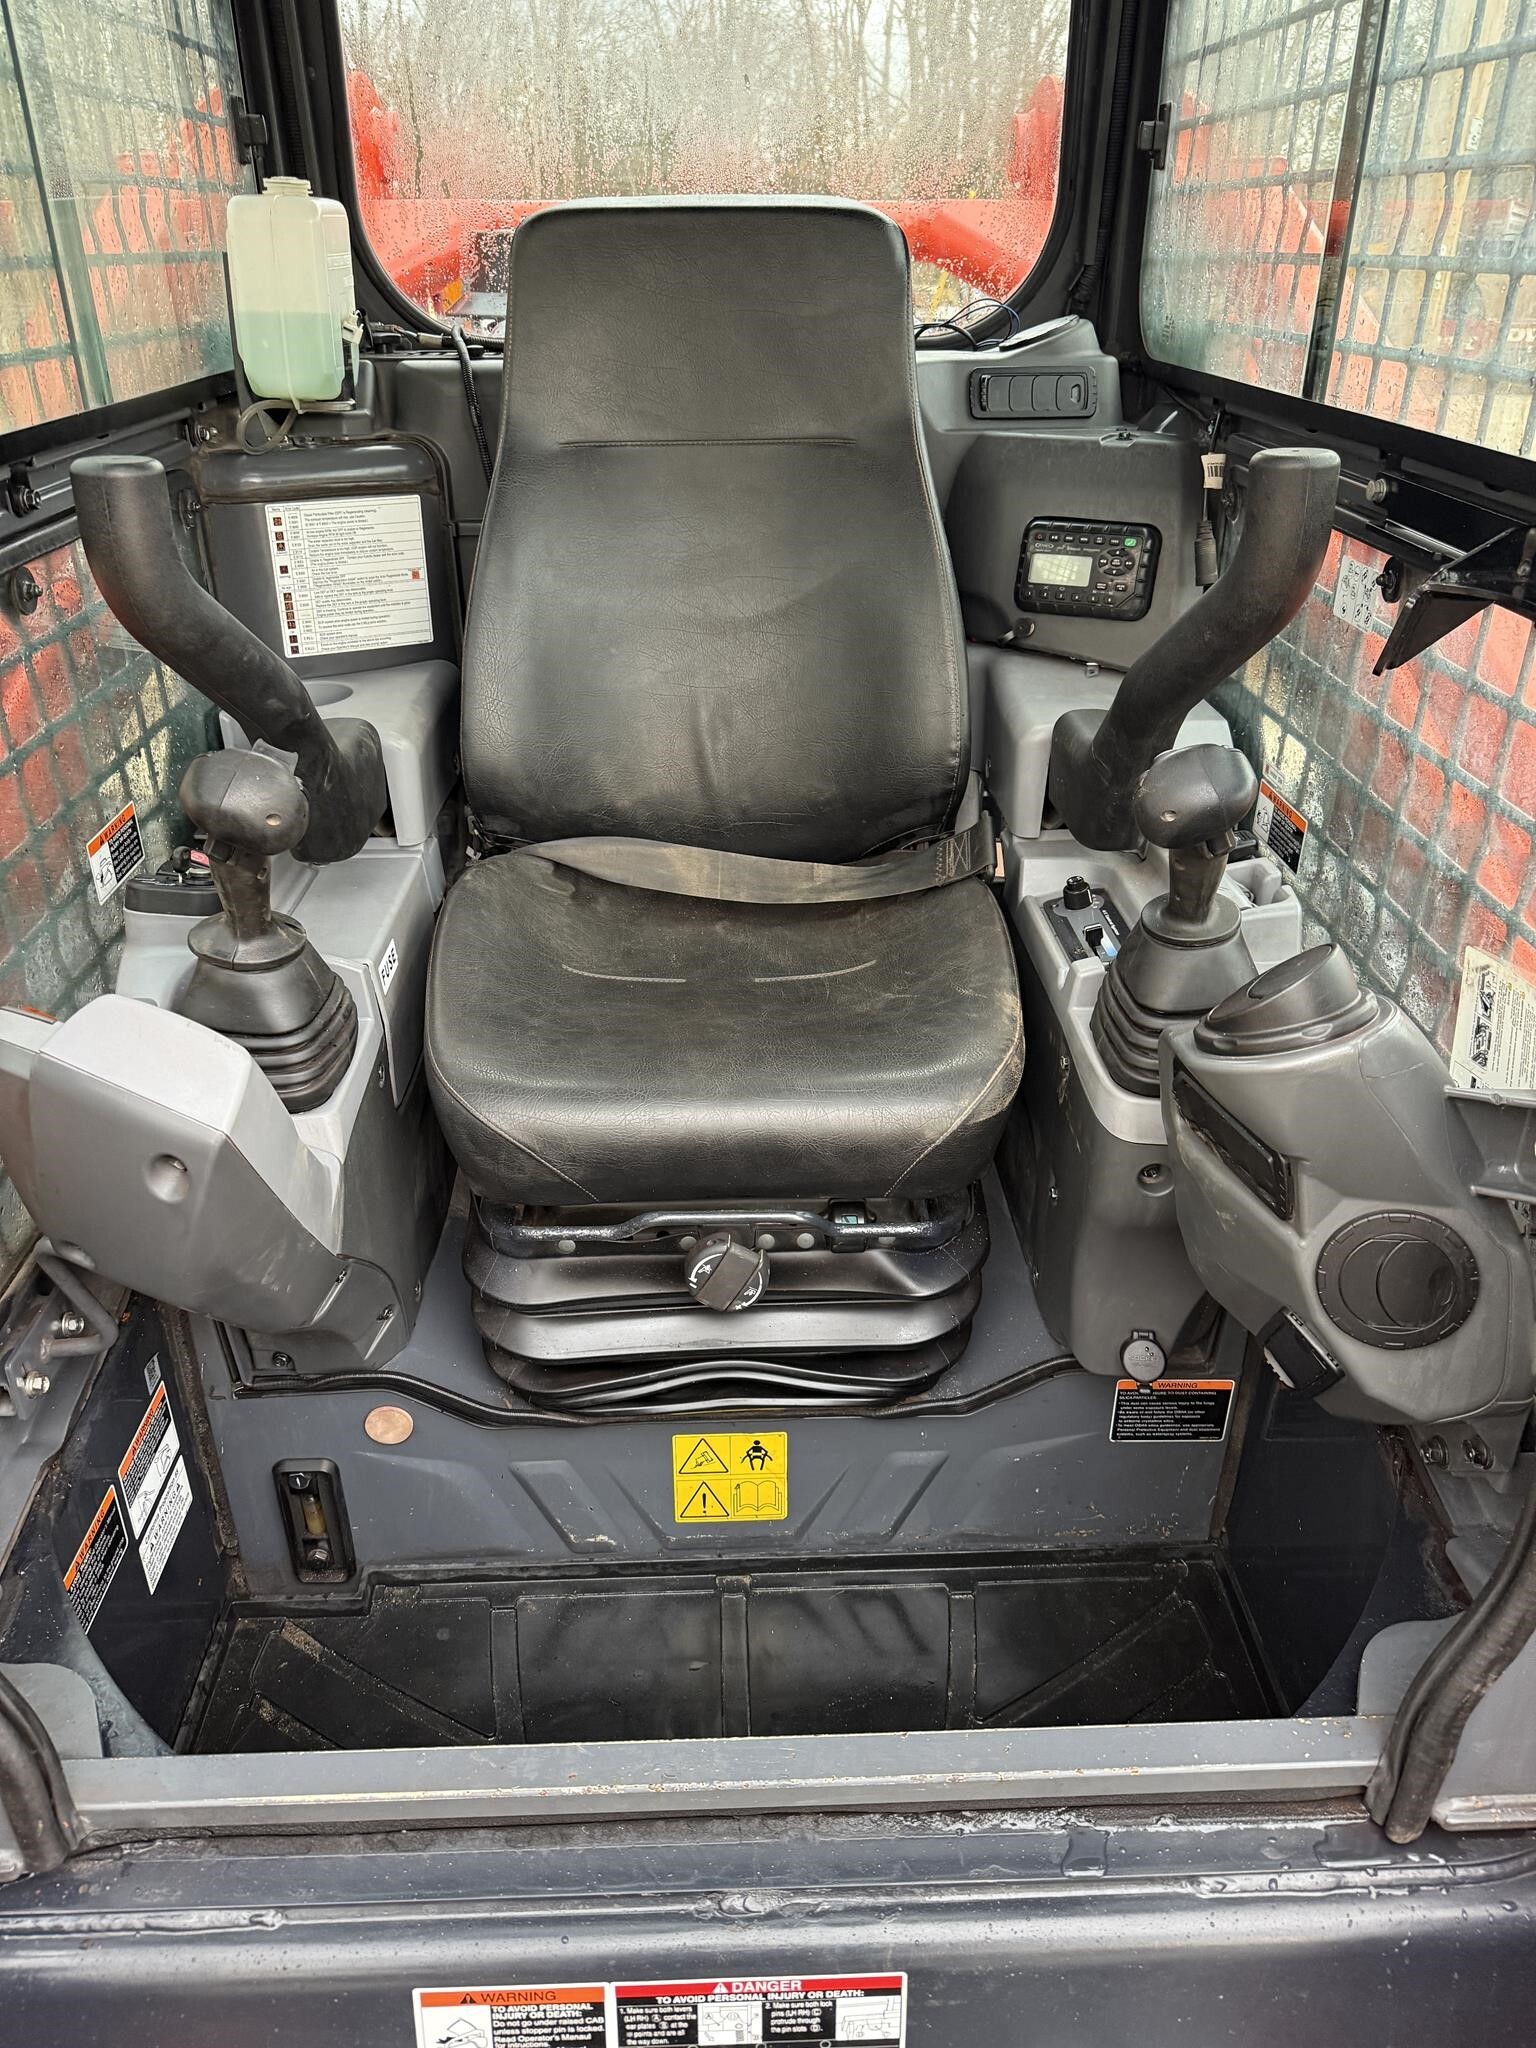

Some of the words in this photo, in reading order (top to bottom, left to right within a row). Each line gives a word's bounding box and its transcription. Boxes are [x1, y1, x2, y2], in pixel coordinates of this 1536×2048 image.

[153, 1489, 175, 1541] WARNING
[79, 1507, 106, 1558] WARNING
[731, 1980, 802, 1993] DANGER
[480, 1991, 556, 2003] WARNING
[656, 1996, 671, 2004] TO
[673, 1995, 706, 2004] AVOID
[707, 1993, 766, 2003] PERSONAL
[767, 1991, 806, 2001] INJURY
[807, 1991, 824, 1999] OR
[825, 1989, 864, 1998] DEATH:
[492, 2005, 506, 2013] TO
[507, 2005, 538, 2013] AVOID
[538, 2003, 594, 2012] PERSONAL
[659, 2006, 673, 2014] both
[492, 2012, 528, 2020] INJURY
[529, 2011, 545, 2019] OR
[546, 2010, 582, 2018] DEATH:
[493, 2020, 505, 2028] Do
[521, 2020, 533, 2028] go
[559, 2017, 584, 2025] raised
[585, 2016, 604, 2024] CAB
[493, 2028, 520, 2036] unless
[521, 2027, 552, 2036] stopper
[553, 2026, 567, 2034] pin
[517, 2034, 560, 2043] Operator's
